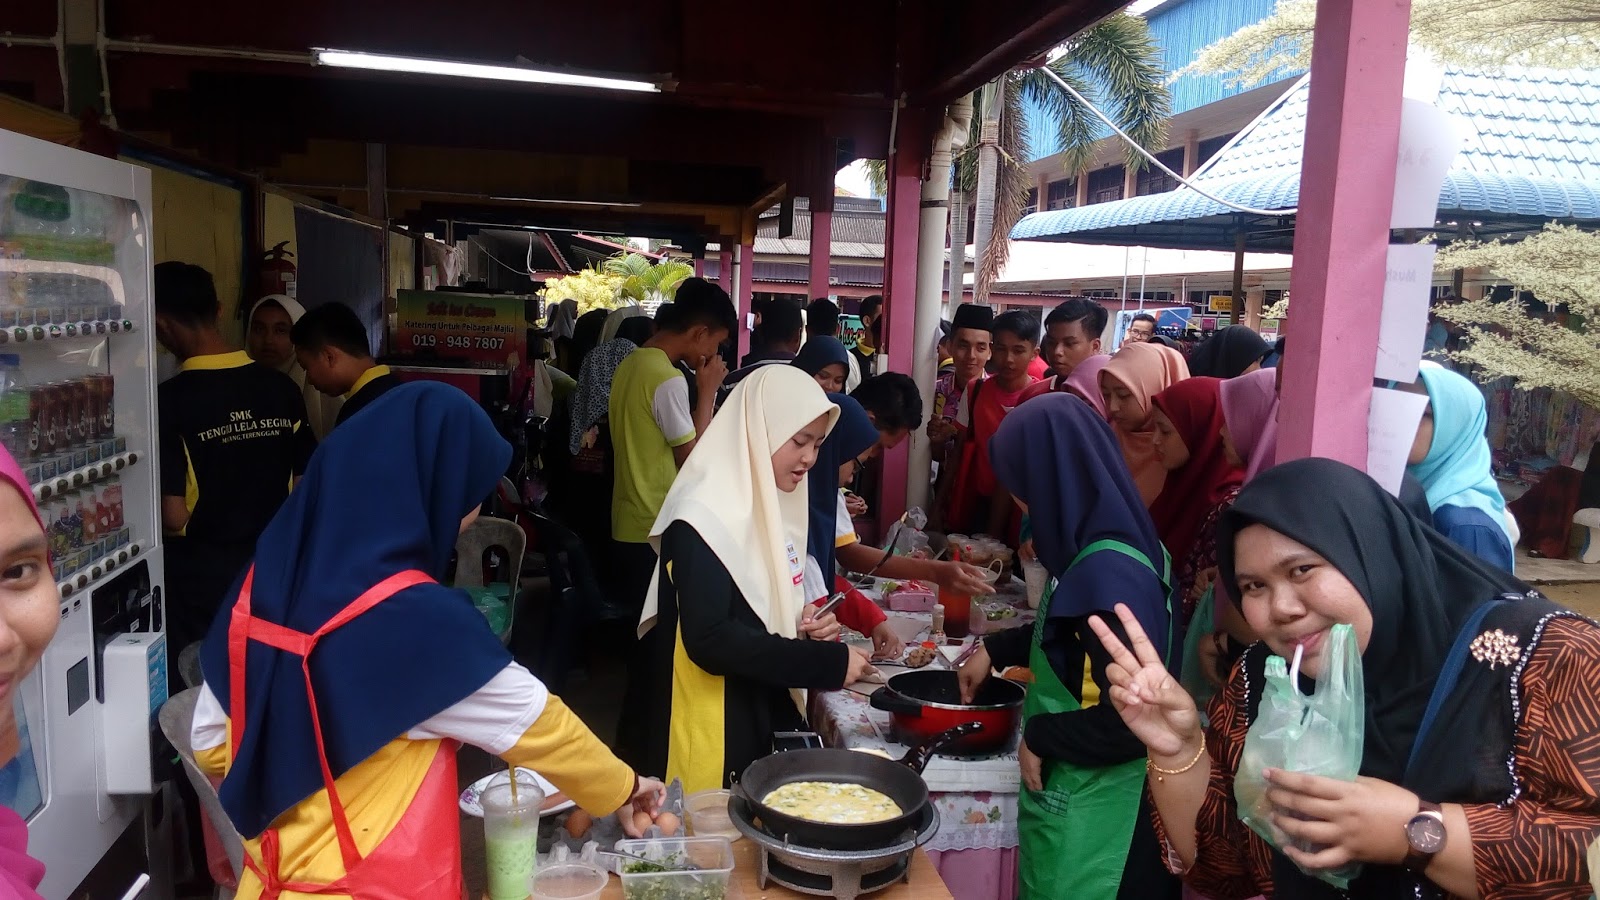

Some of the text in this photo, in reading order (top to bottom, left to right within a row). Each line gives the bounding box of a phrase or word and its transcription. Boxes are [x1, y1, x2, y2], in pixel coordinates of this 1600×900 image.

[405, 320, 514, 335] Katering Untuk Pelbagai Majlis
[412, 334, 436, 346] 019
[446, 335, 471, 348] 948
[474, 337, 504, 349] 7807
[230, 410, 252, 421] SMK
[234, 421, 257, 432] LELA
